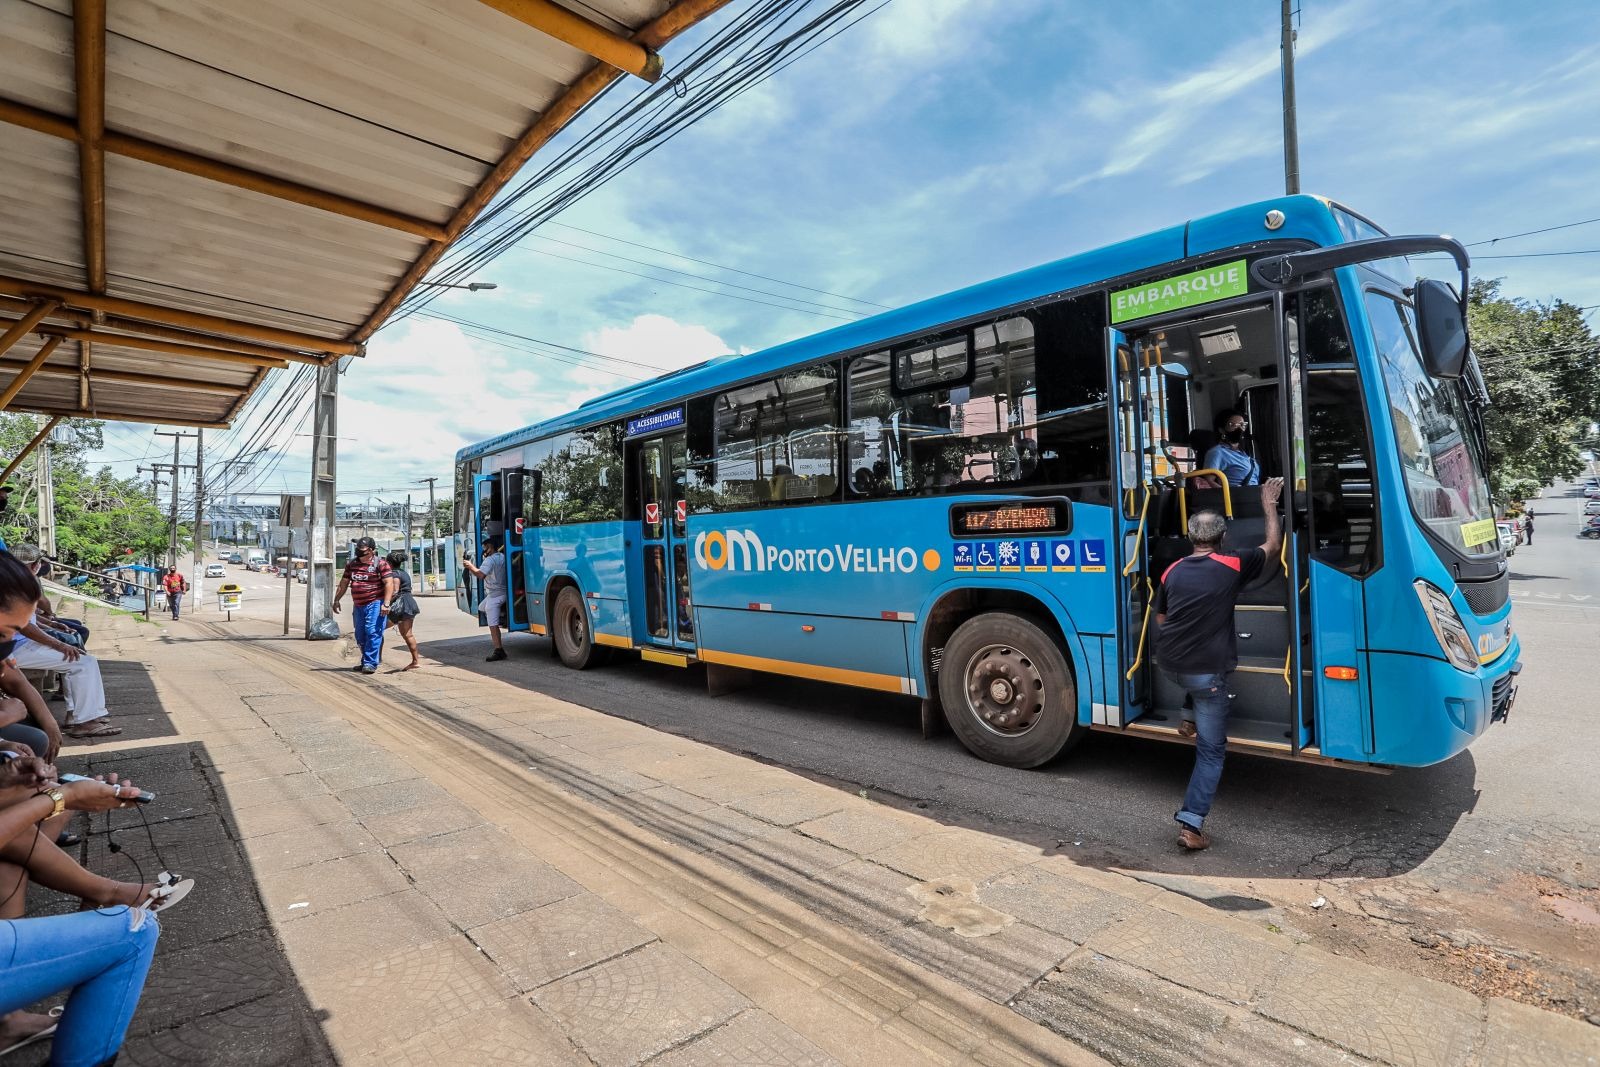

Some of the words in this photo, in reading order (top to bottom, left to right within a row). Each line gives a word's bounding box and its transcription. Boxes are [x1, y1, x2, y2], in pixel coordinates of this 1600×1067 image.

[1116, 267, 1240, 310] EMBARQUE
[1117, 282, 1240, 318] BOARDING
[636, 410, 681, 428] ACESSIBILIDADE
[996, 507, 1047, 519] AVENIDA
[990, 517, 1050, 529] SETEMBRO
[954, 555, 972, 563] Wi-Fi
